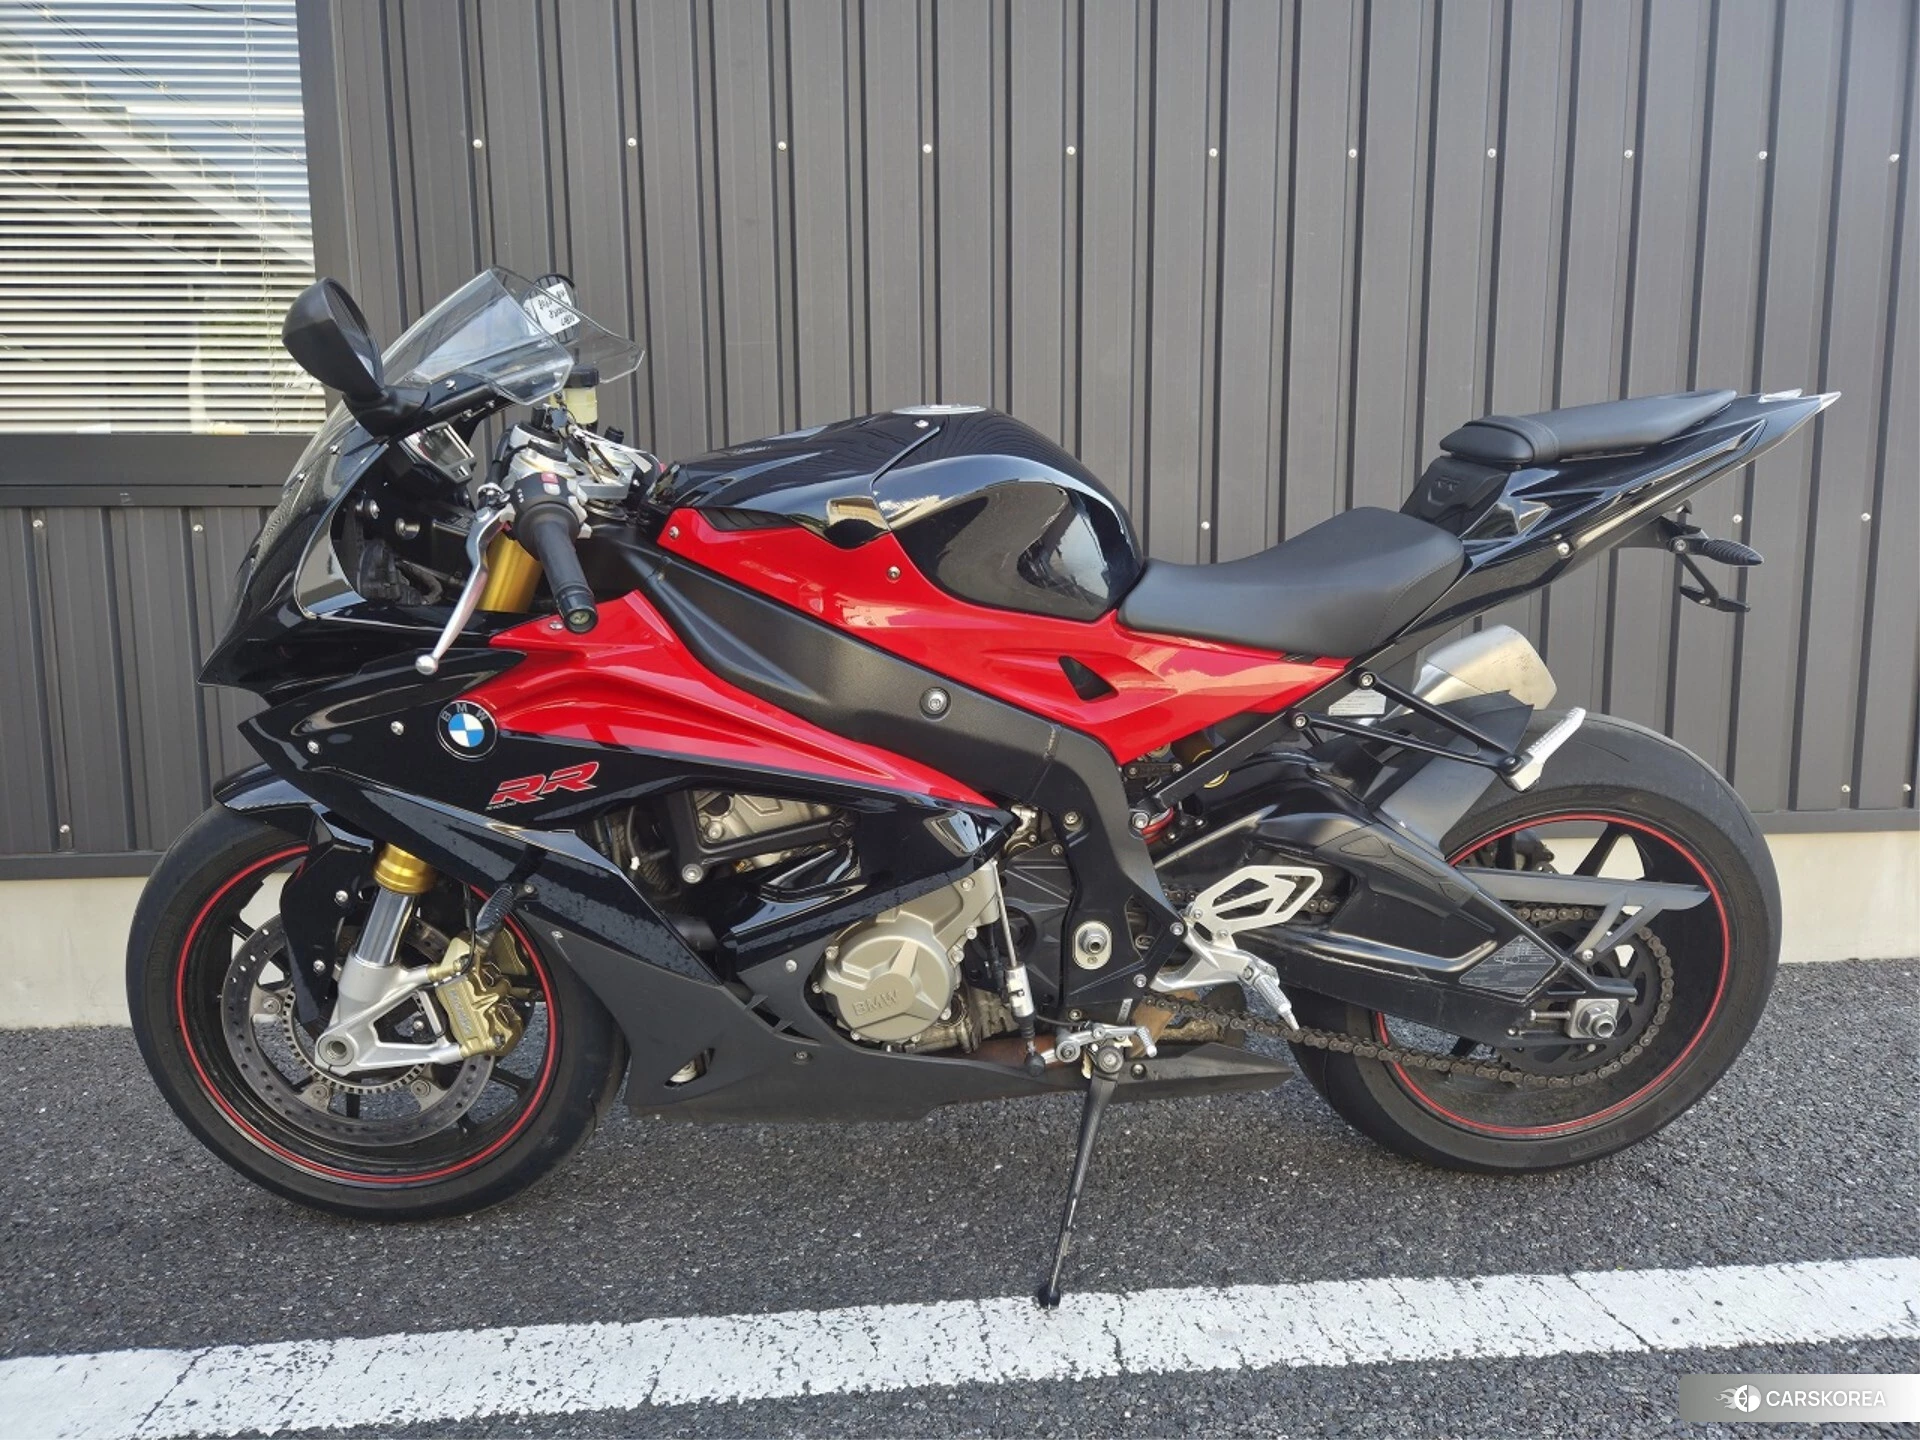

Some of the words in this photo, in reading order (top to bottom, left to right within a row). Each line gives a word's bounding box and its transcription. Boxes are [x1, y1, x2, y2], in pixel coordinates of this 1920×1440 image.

[440, 702, 489, 722] BMW
[488, 761, 600, 805] RR
[852, 989, 899, 1016] BMW
